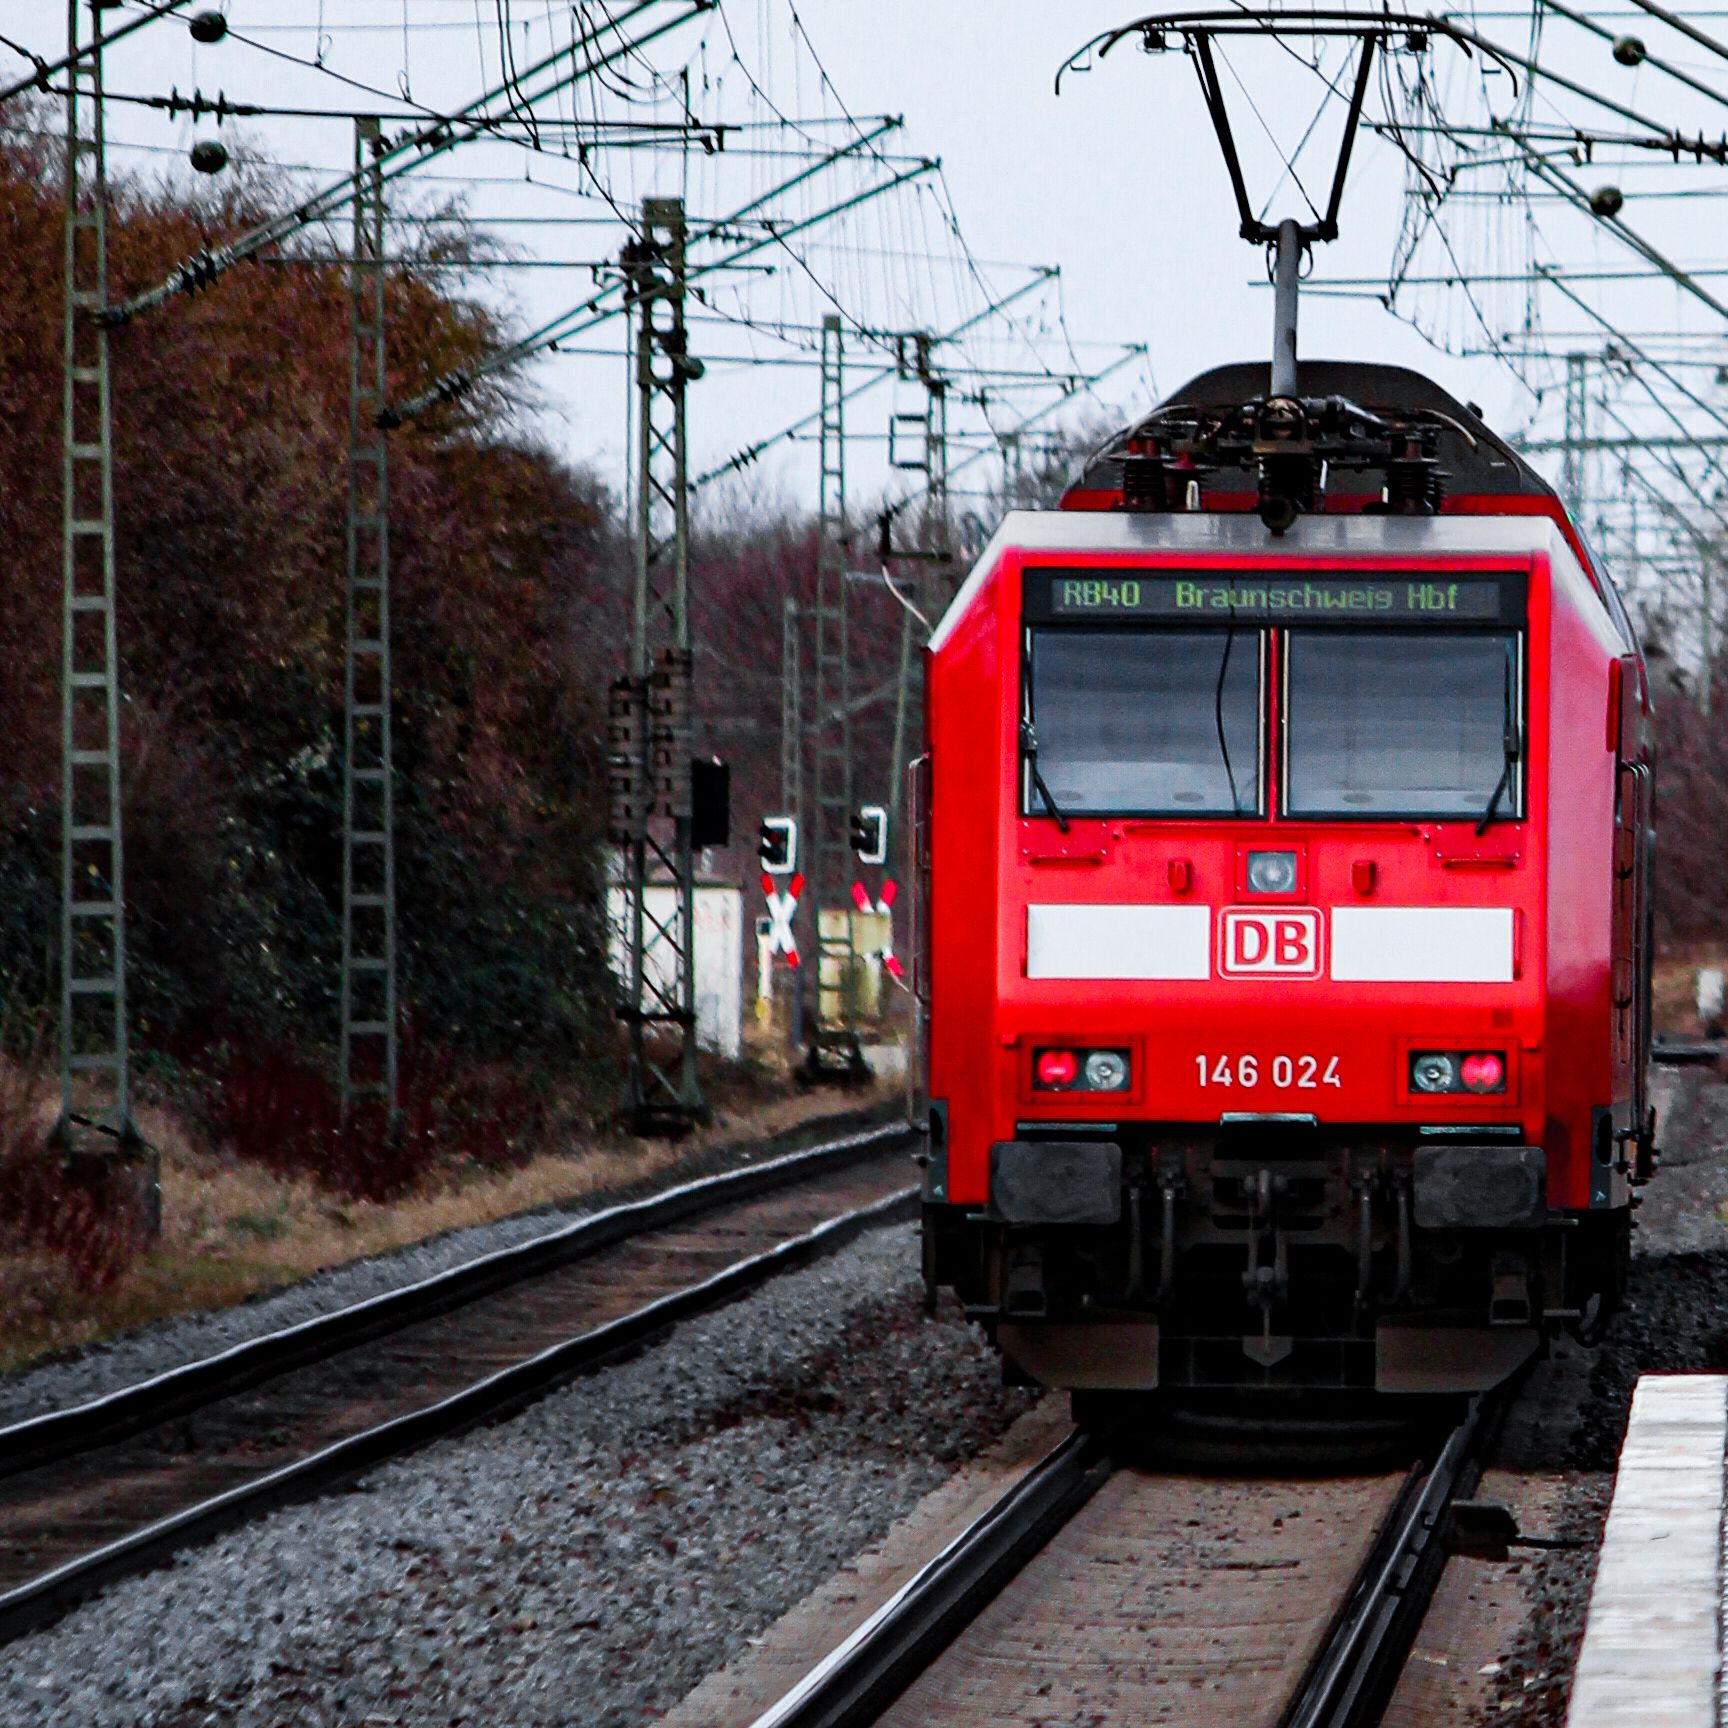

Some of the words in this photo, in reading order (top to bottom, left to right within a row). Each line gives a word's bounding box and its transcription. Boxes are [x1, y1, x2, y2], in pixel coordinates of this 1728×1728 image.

[1063, 580, 1141, 608] RB40
[1175, 581, 1393, 610] Braunschweig
[1407, 583, 1457, 610] Hbf
[1234, 920, 1309, 966] DB
[1196, 1054, 1259, 1088] 146
[1272, 1055, 1342, 1089] 024
